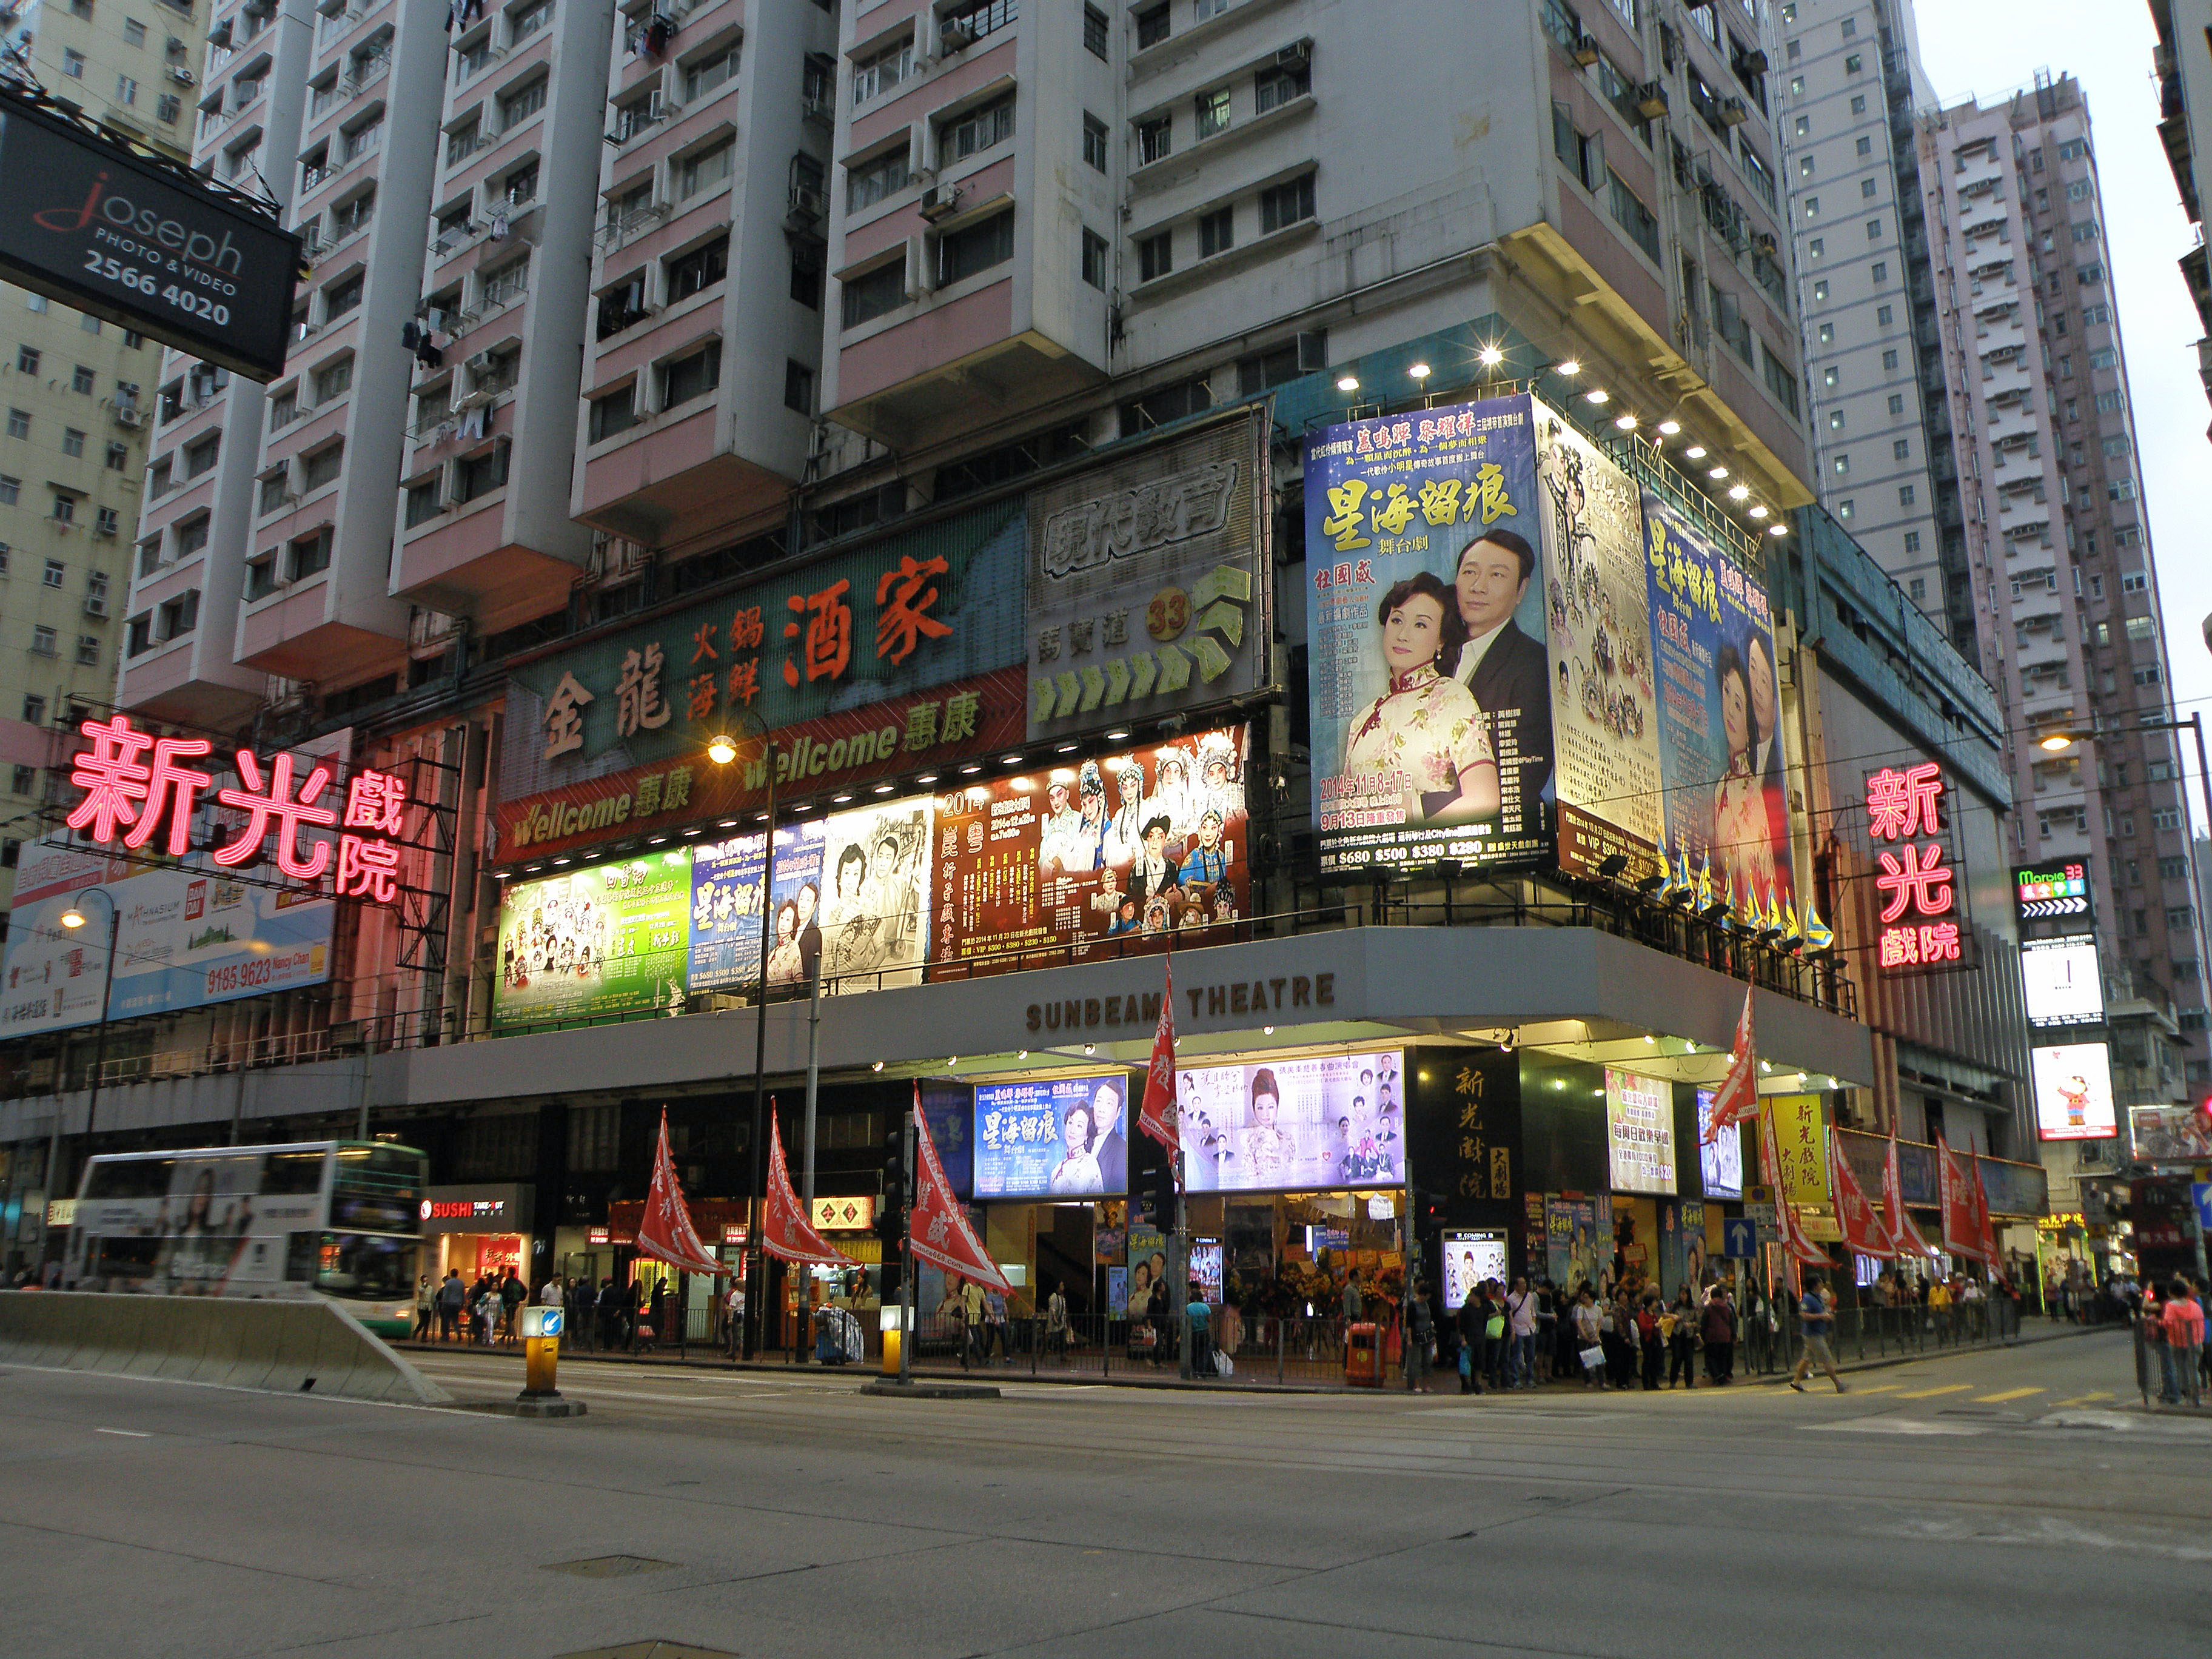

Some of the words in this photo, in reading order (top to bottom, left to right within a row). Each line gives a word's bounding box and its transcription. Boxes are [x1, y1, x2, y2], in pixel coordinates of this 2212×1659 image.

[33, 172, 243, 275] joseph
[95, 227, 161, 263] PHOTO
[166, 259, 179, 272] &
[184, 264, 237, 297] VIDEO
[84, 250, 156, 295] 2566
[162, 283, 229, 326] 4020
[1324, 463, 1518, 551] 星海留痕
[1378, 535, 1429, 557] 舞台劇
[1314, 559, 1376, 591] 杜國威
[691, 606, 765, 666] 火鍋
[1148, 594, 1186, 634] 33
[541, 641, 672, 761] 金龍
[783, 554, 954, 688] 酒家
[686, 657, 759, 722] 海鮮
[743, 728, 898, 791] Wellcome
[902, 691, 980, 751] 惠康
[67, 716, 335, 879] 新光
[512, 791, 632, 849] Wellcome
[634, 766, 693, 820] 惠康
[942, 791, 985, 818] 2014
[1320, 769, 1412, 801] 2014年11月8-17日
[335, 769, 406, 903] 戲院
[1321, 808, 1407, 831] 9月13日隆重發售
[1587, 834, 1600, 850] VIP
[1867, 762, 1952, 923] 新光
[1339, 850, 1371, 865] $680
[1375, 846, 1408, 862] $500
[1412, 843, 1446, 859] $380
[2065, 863, 2083, 880] 33
[273, 956, 292, 971] Nancy
[293, 953, 310, 965] Chan
[976, 945, 987, 954] VIP
[988, 943, 1001, 952] $500
[1043, 935, 1057, 945] $150
[1880, 922, 1962, 969] 戲院
[208, 963, 237, 994] 9185
[241, 958, 271, 988] 9623
[1026, 992, 1161, 1031] SUNBEAM
[1187, 973, 1336, 1018] THEATRE
[982, 1110, 1059, 1150] 星海留痕
[1455, 1066, 1486, 1199] 新光戲院
[1795, 1104, 1820, 1187] 新光戲院
[1493, 1148, 1507, 1197] 大劇場
[1659, 1164, 1673, 1181] $20
[433, 1202, 473, 1218] SUSHI
